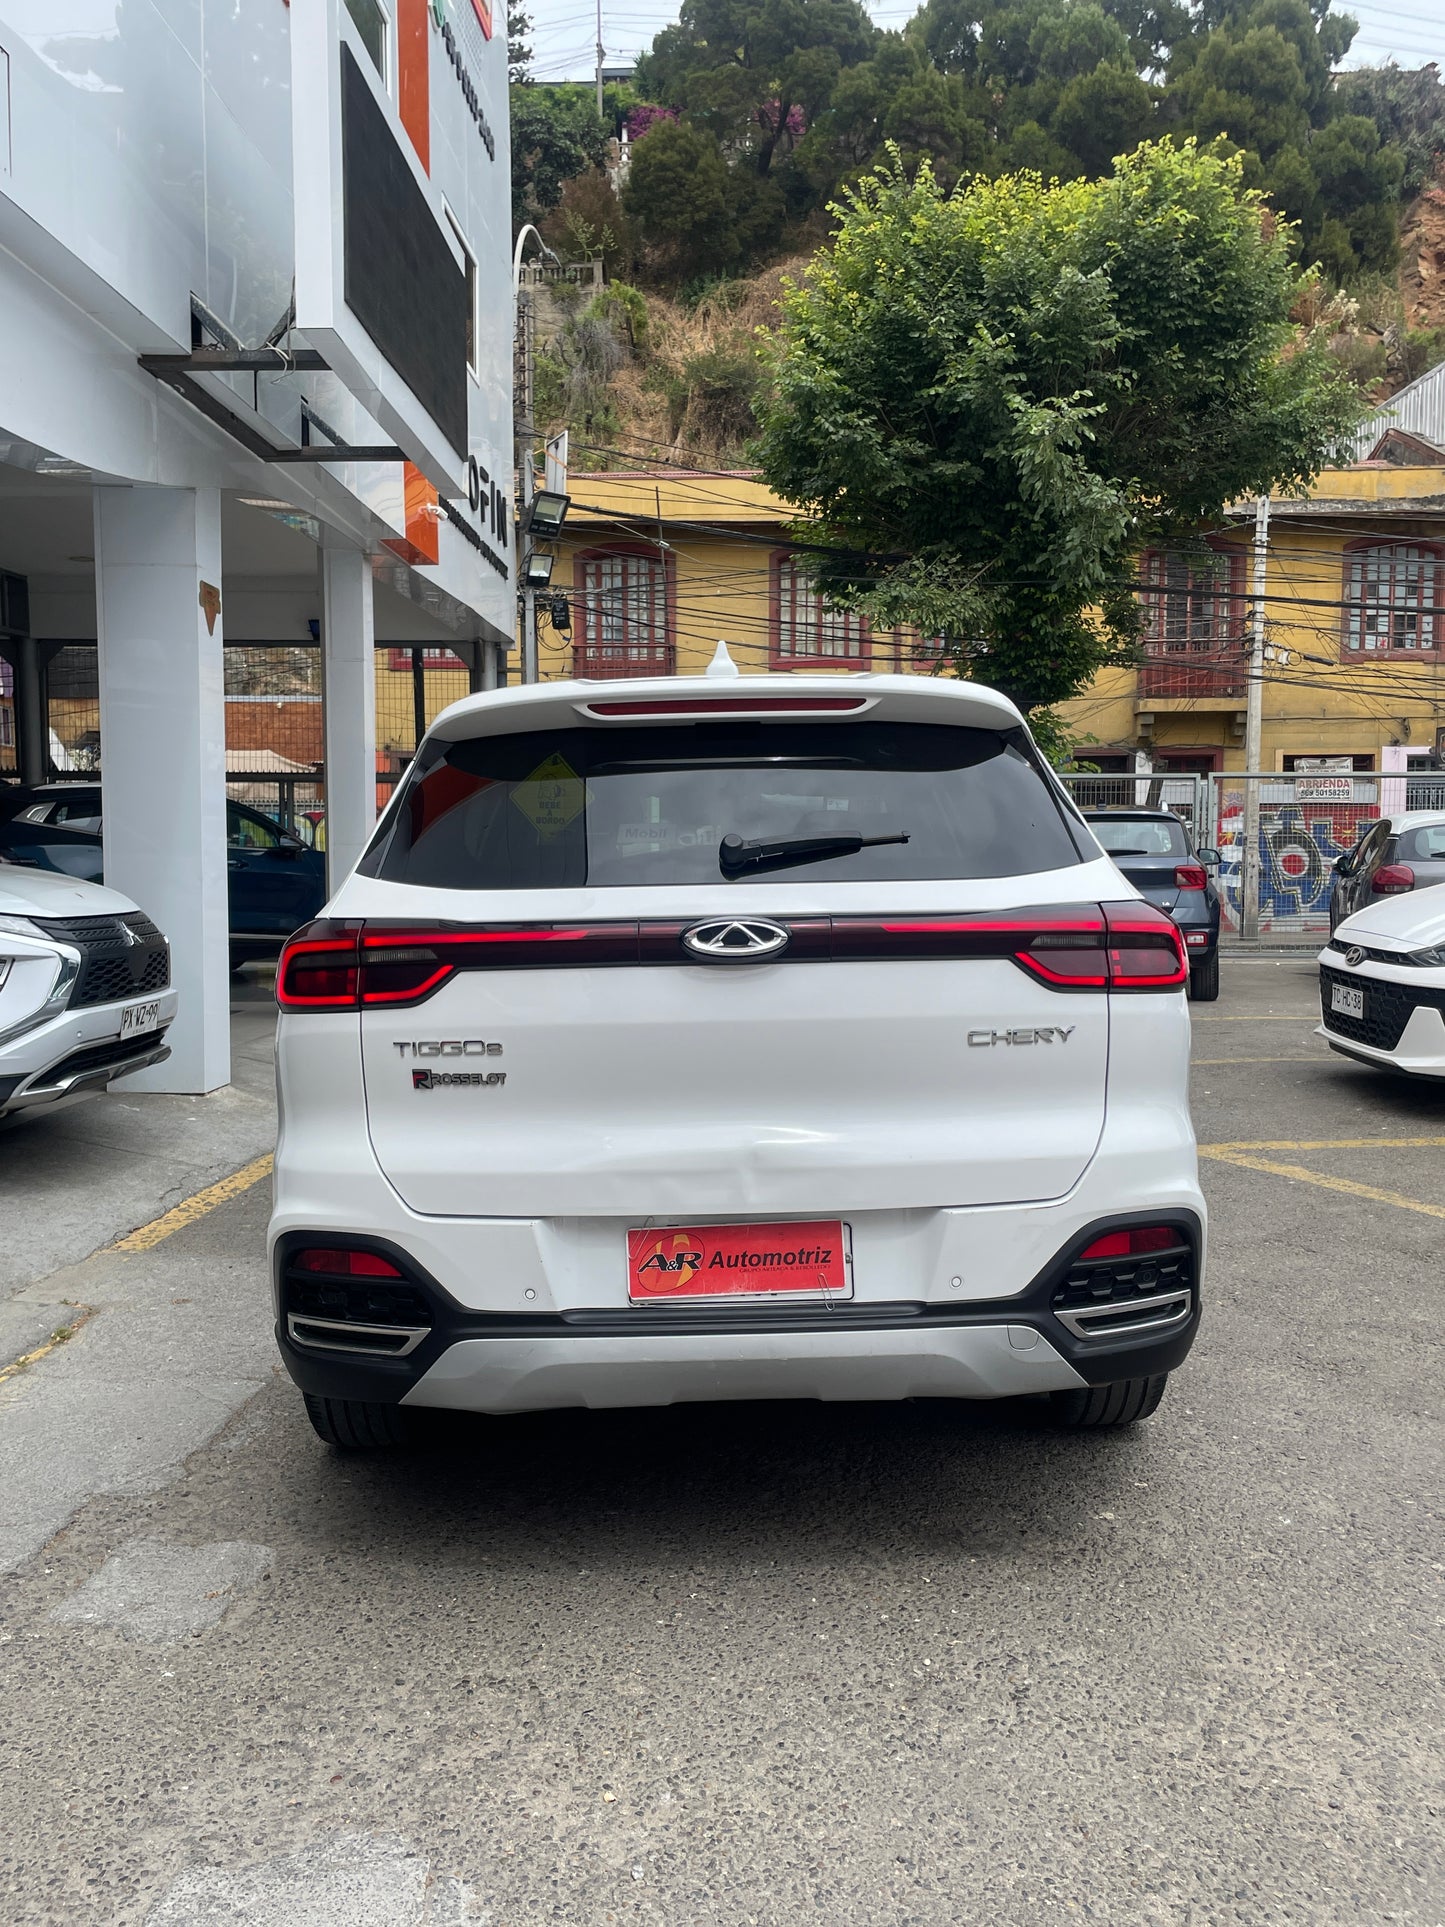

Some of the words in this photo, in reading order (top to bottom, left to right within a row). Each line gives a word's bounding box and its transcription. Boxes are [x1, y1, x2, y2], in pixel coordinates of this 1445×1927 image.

[1299, 779, 1350, 788] ARRIENDA
[624, 827, 667, 839] Mobil
[967, 1025, 1076, 1046] CHERY
[637, 1252, 703, 1274] A&R
[708, 1246, 832, 1269] Automotriz
